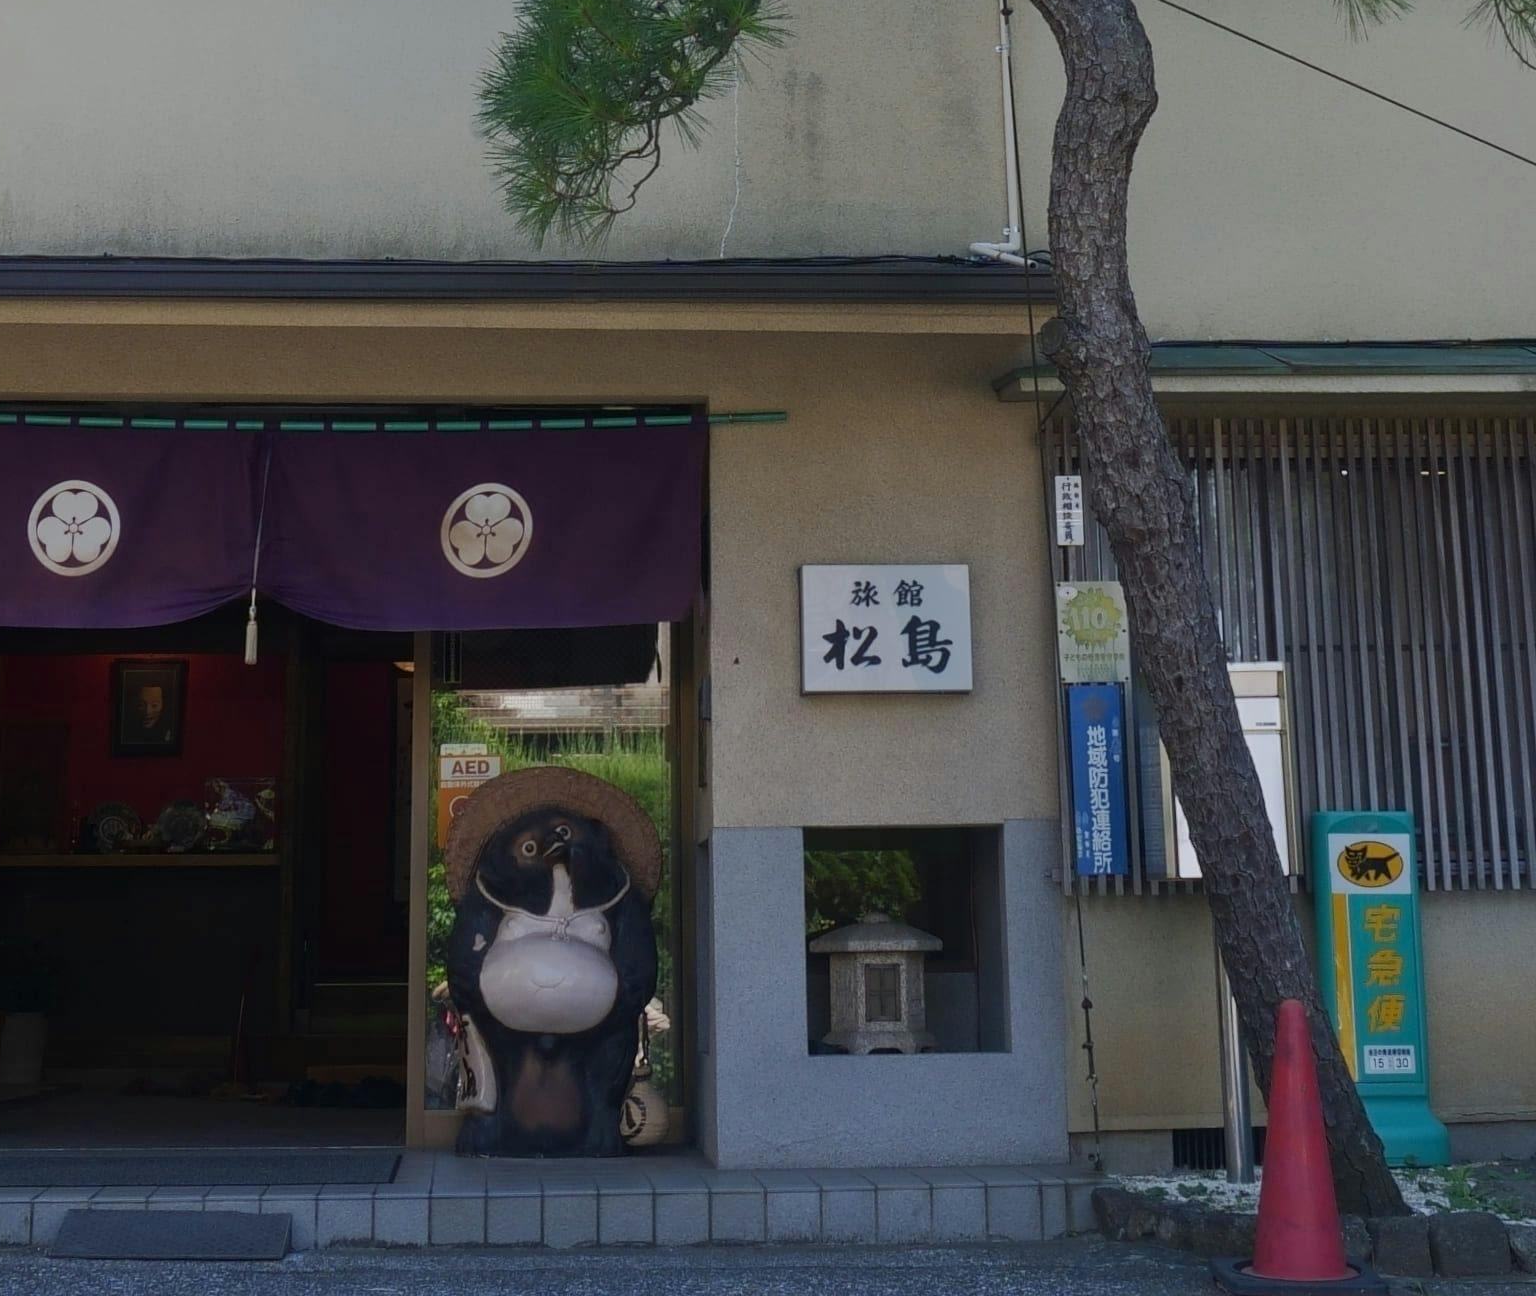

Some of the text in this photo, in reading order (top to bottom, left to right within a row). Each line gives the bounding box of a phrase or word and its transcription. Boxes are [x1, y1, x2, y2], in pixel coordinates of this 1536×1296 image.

[850, 580, 924, 607] 旅館
[822, 615, 953, 674] 松島
[452, 760, 490, 775] AED
[1086, 724, 1113, 874] 地域防犯連絡所
[1363, 903, 1405, 1033] 宅急便
